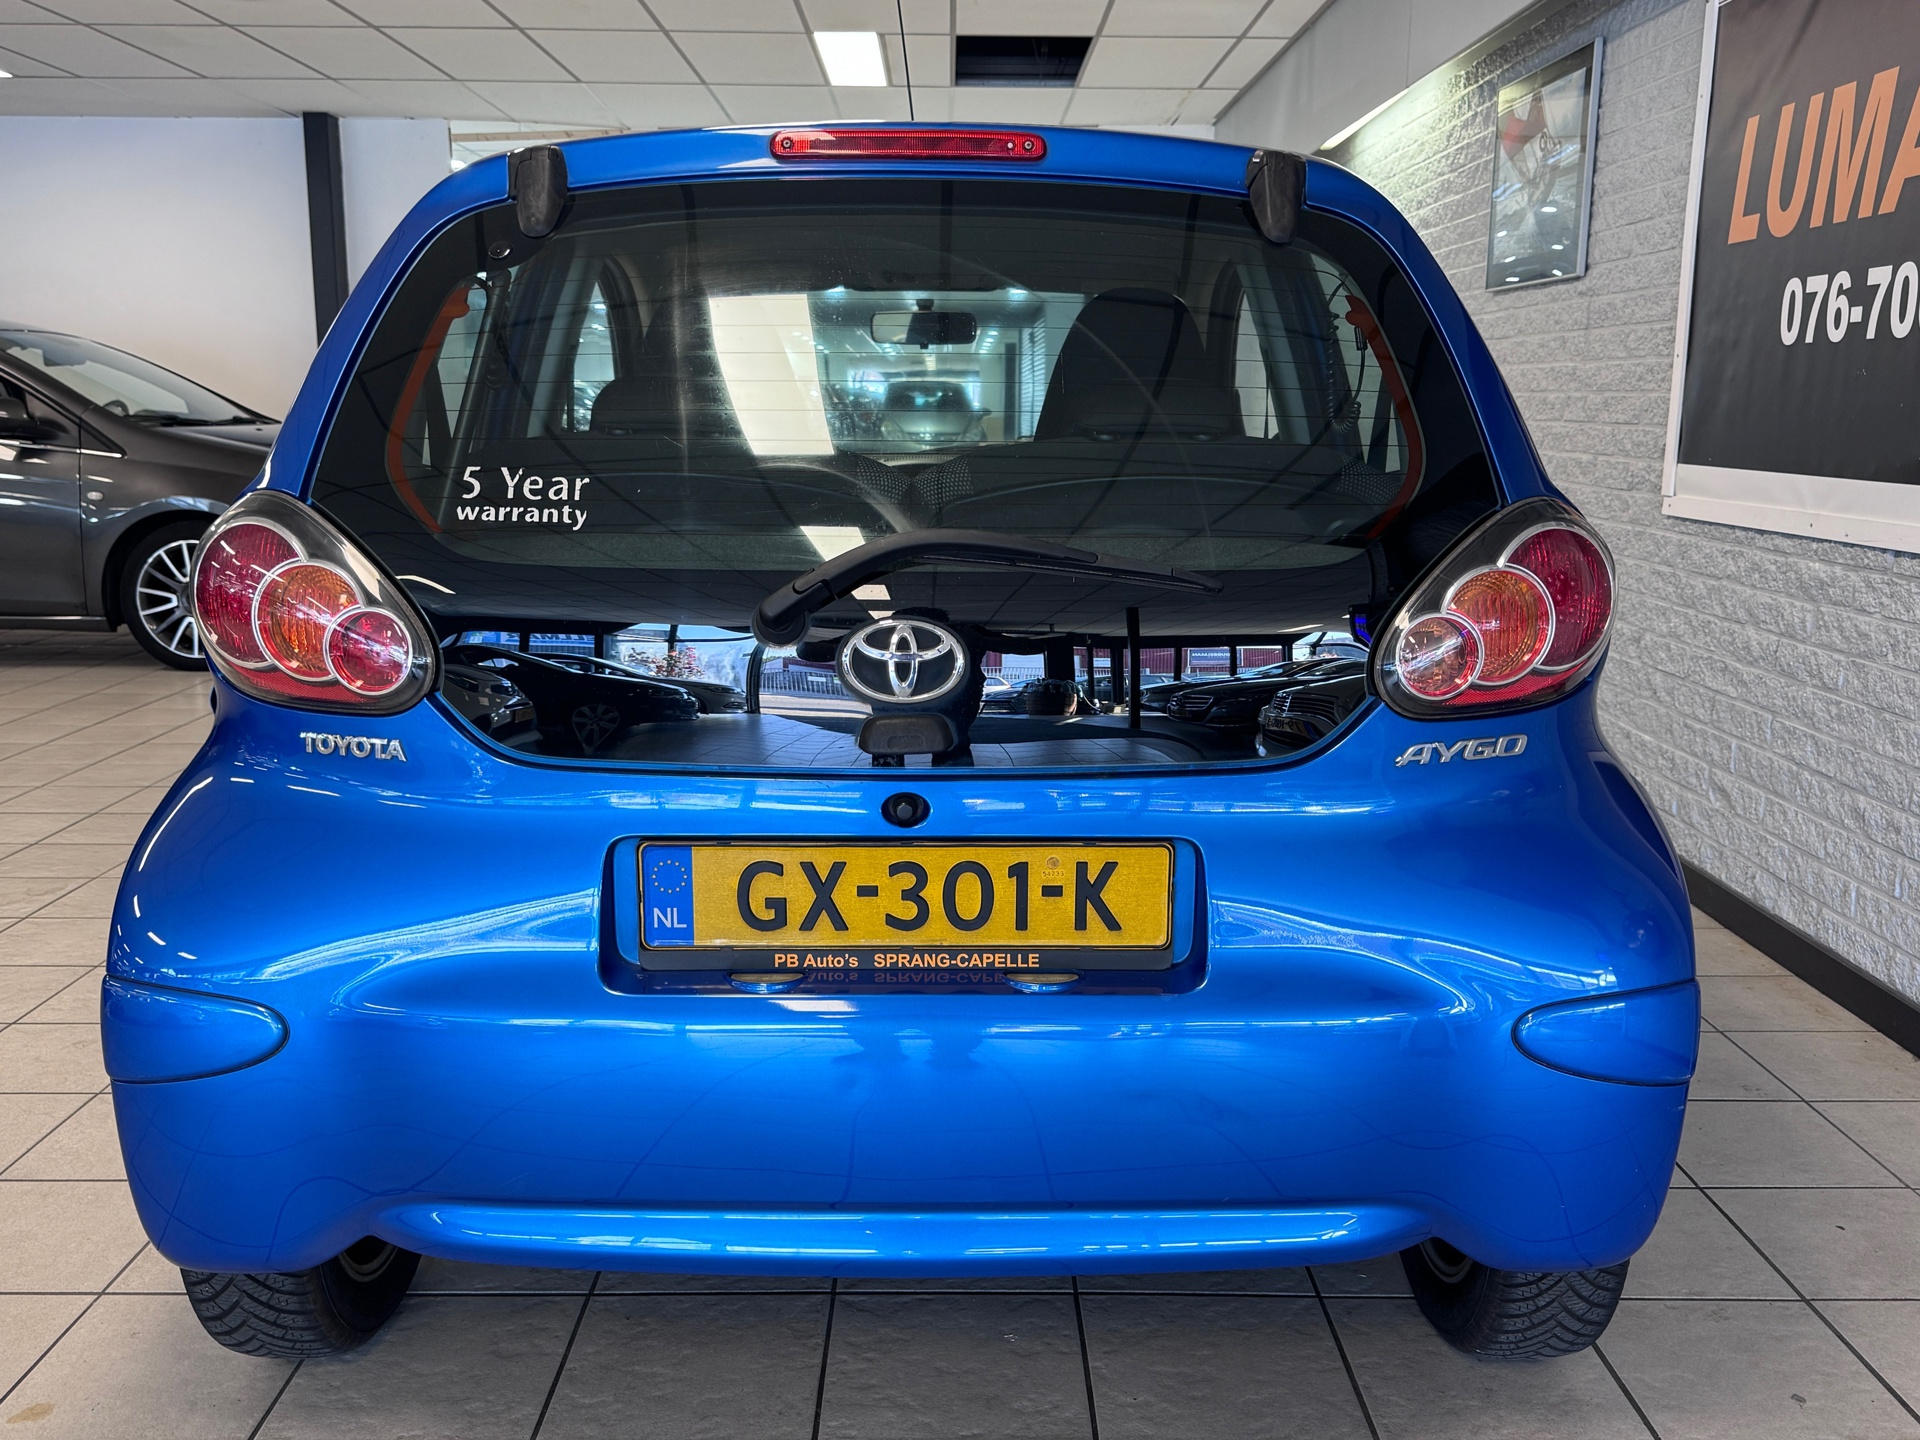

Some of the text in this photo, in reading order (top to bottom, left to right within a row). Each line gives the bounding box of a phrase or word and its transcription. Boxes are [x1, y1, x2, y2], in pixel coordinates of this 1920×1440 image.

[1779, 260, 1920, 347] 076-70
[461, 465, 591, 501] 5 Year
[456, 504, 588, 531] warranty
[299, 731, 407, 762] TOYOTA
[1394, 734, 1528, 767] AYGO
[736, 860, 1123, 933] GX-301-K
[653, 907, 688, 929] NL
[774, 953, 1040, 968] PB Auto's SPRANG-CAPELLE
